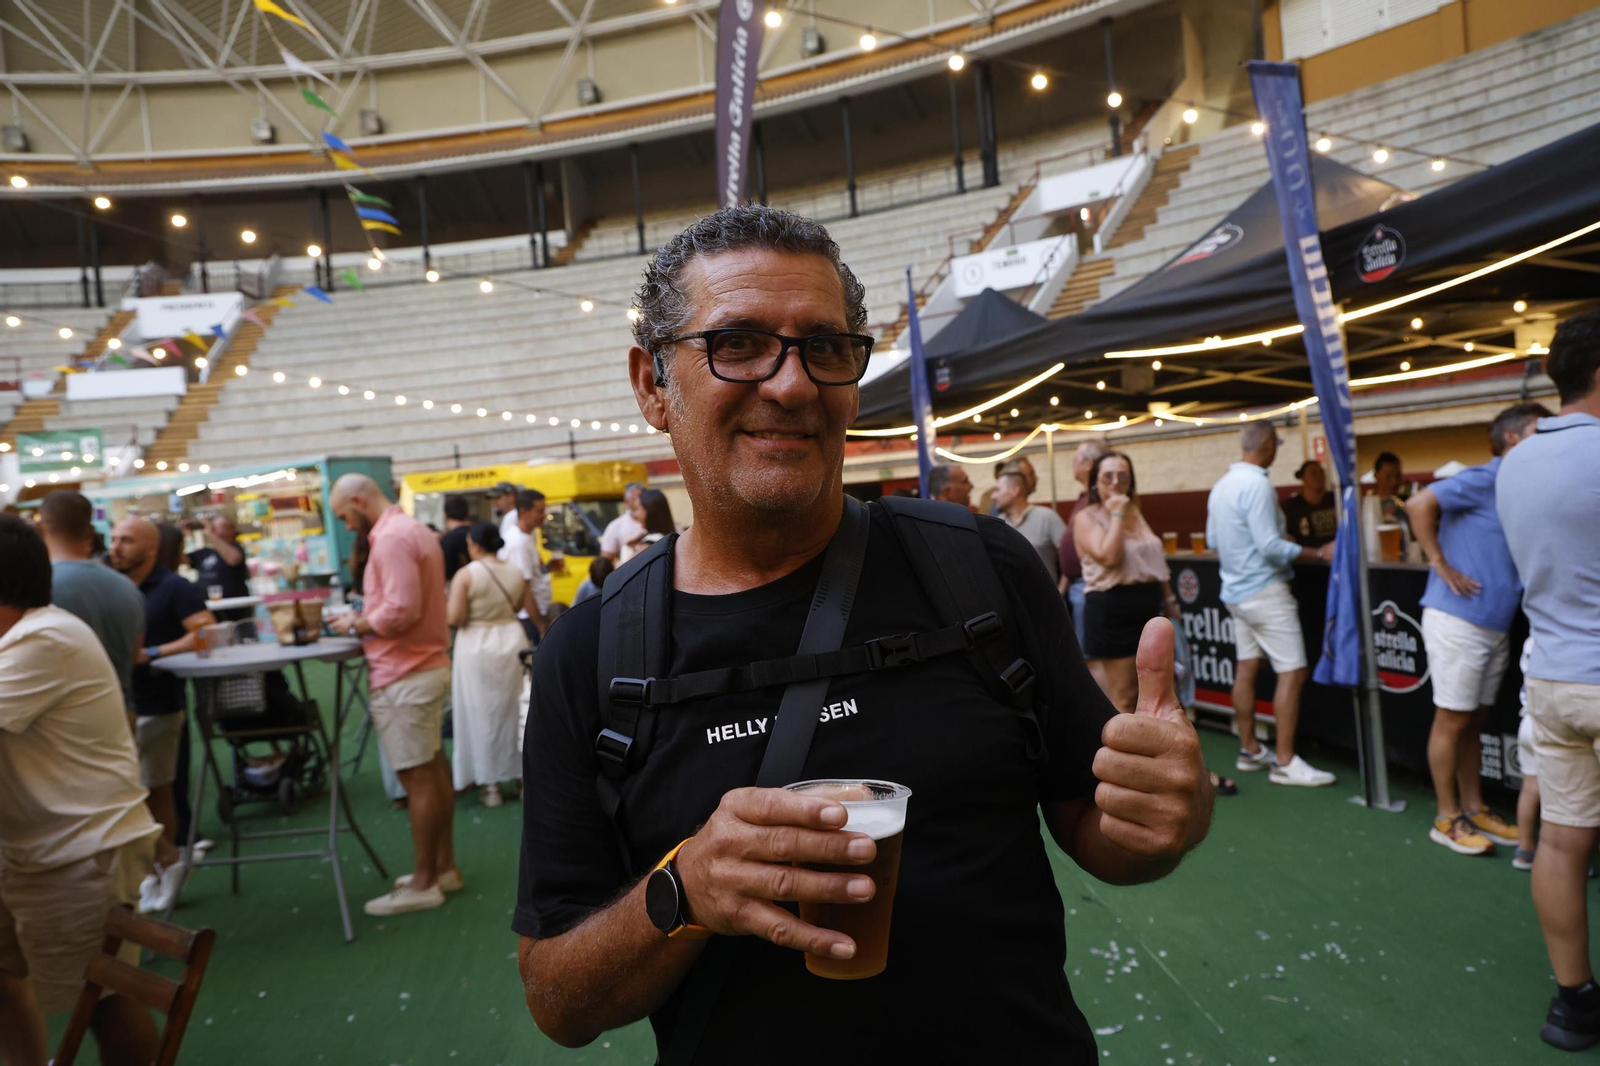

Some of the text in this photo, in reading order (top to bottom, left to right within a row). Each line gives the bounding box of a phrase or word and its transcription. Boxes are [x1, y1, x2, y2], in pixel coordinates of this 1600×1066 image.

[729, 25, 748, 128] Galicia
[1182, 607, 1236, 645] rella
[1373, 630, 1418, 653] strella
[1191, 643, 1234, 685] icia
[706, 717, 768, 744] HELLY
